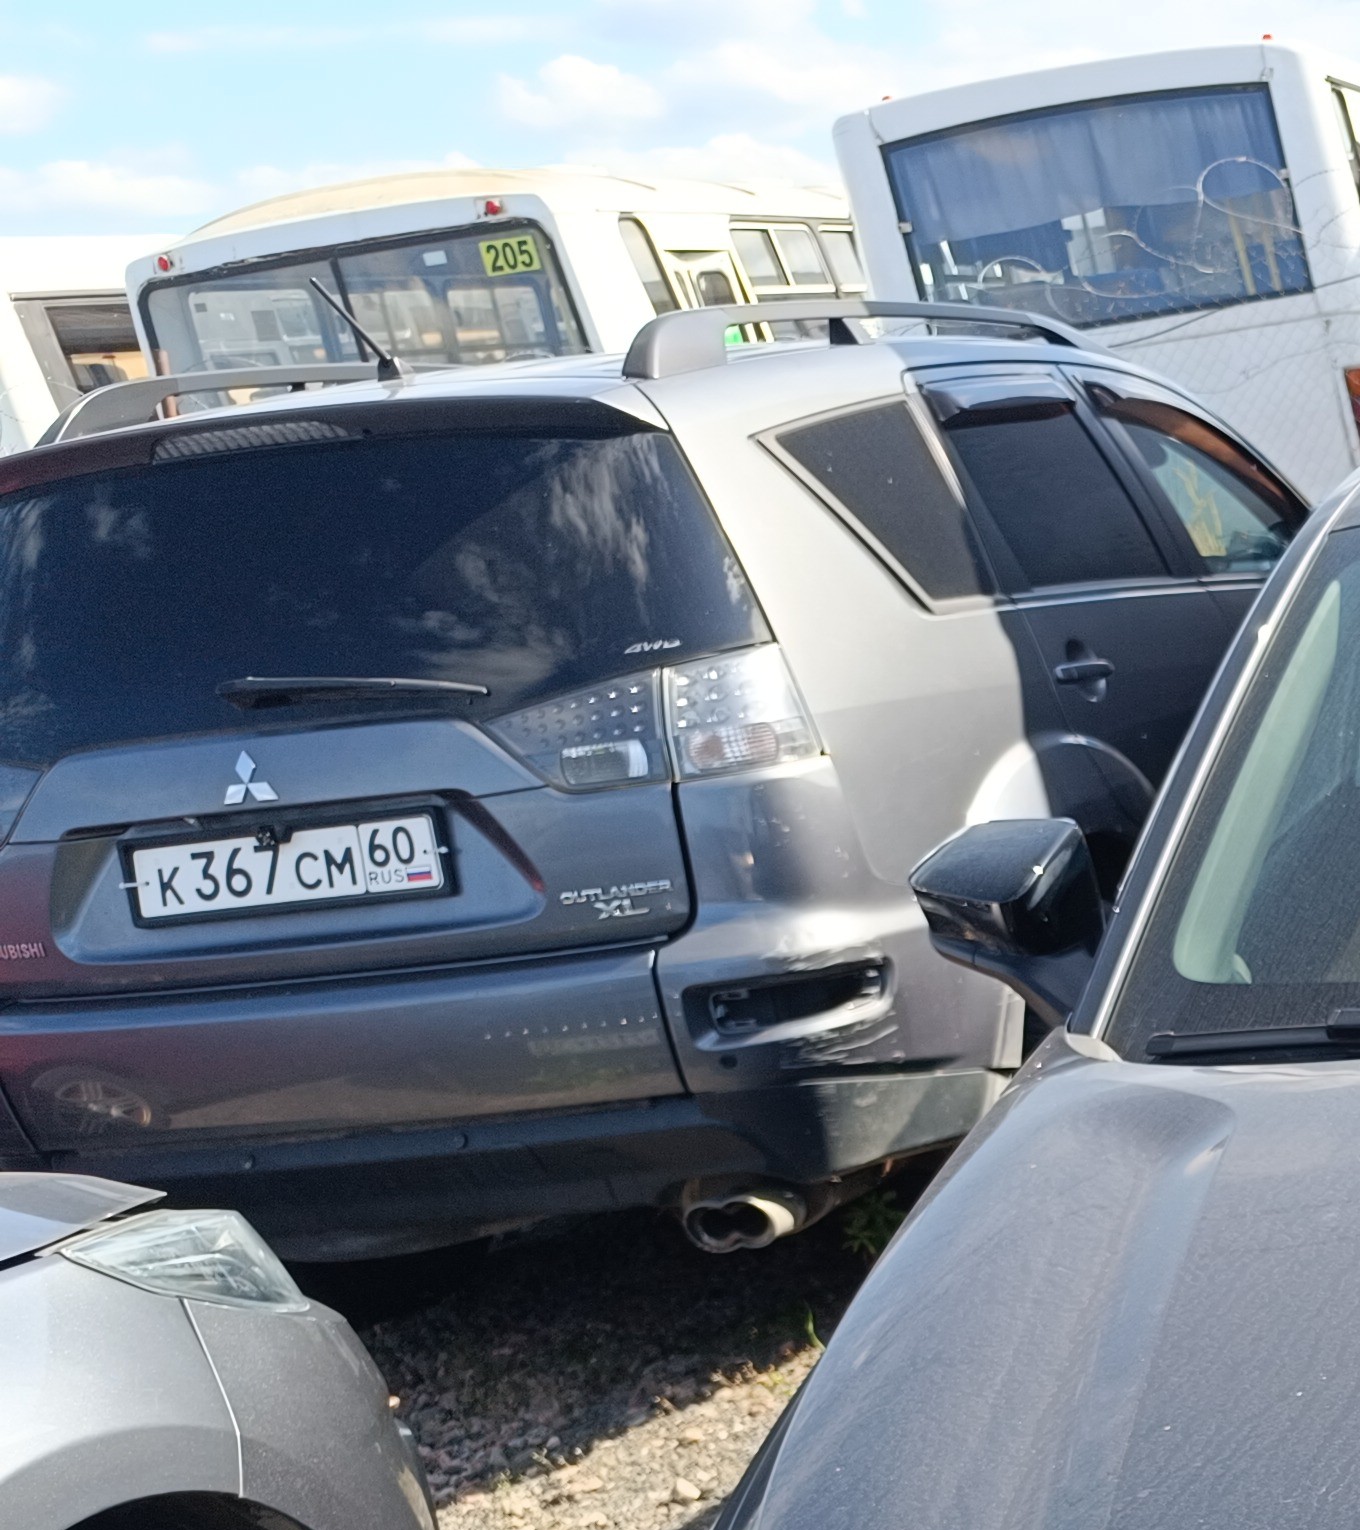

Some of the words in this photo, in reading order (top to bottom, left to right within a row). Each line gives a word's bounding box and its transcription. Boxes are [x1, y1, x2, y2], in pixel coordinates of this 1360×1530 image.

[486, 240, 534, 272] 205
[367, 826, 415, 867] 60
[368, 866, 405, 886] RUS
[560, 879, 672, 905] OUTLANDER
[593, 898, 650, 920] XL
